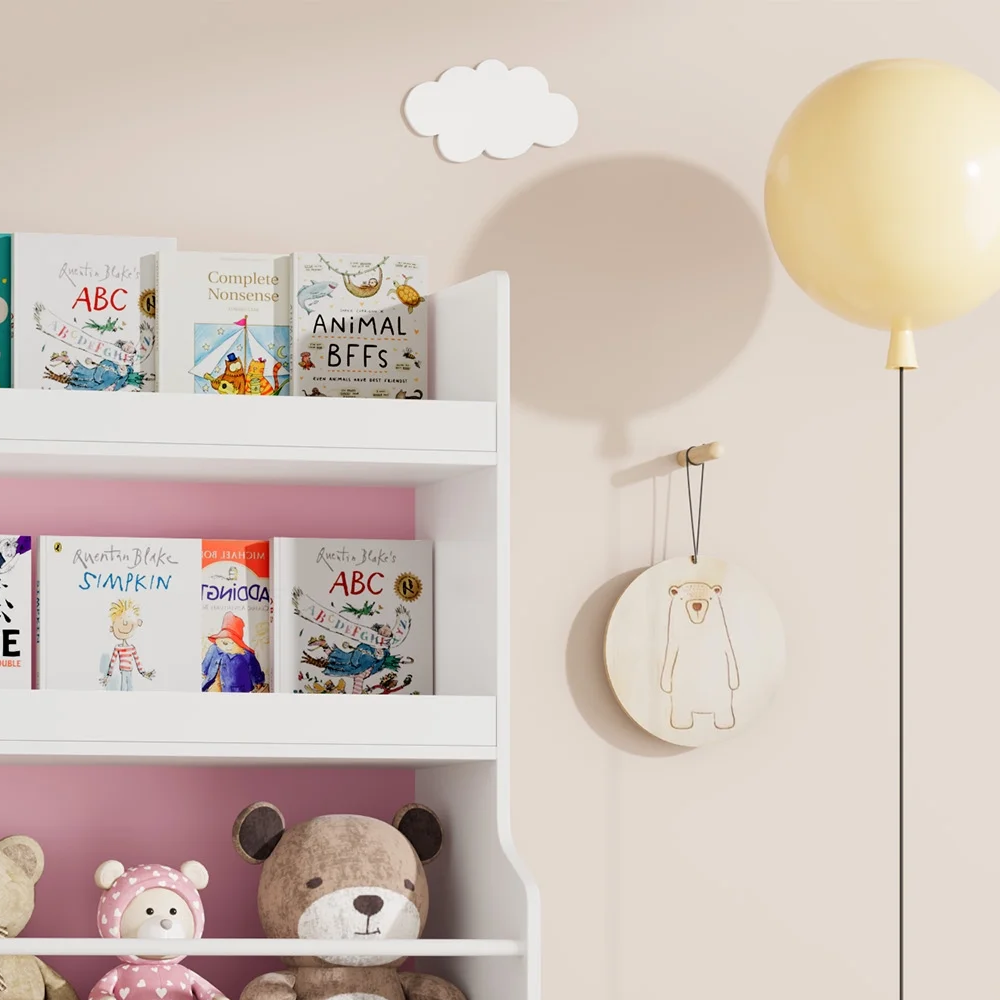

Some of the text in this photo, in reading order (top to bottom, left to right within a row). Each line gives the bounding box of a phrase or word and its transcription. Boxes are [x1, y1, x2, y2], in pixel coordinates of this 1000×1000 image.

[208, 271, 279, 288] Complete
[72, 286, 128, 312] ABC
[208, 288, 279, 302] Nonsense
[73, 545, 179, 569] Quentin Blake
[316, 546, 397, 572] Quentin Blake's
[79, 572, 172, 592] SIMPKIN
[329, 571, 384, 596] ABC
